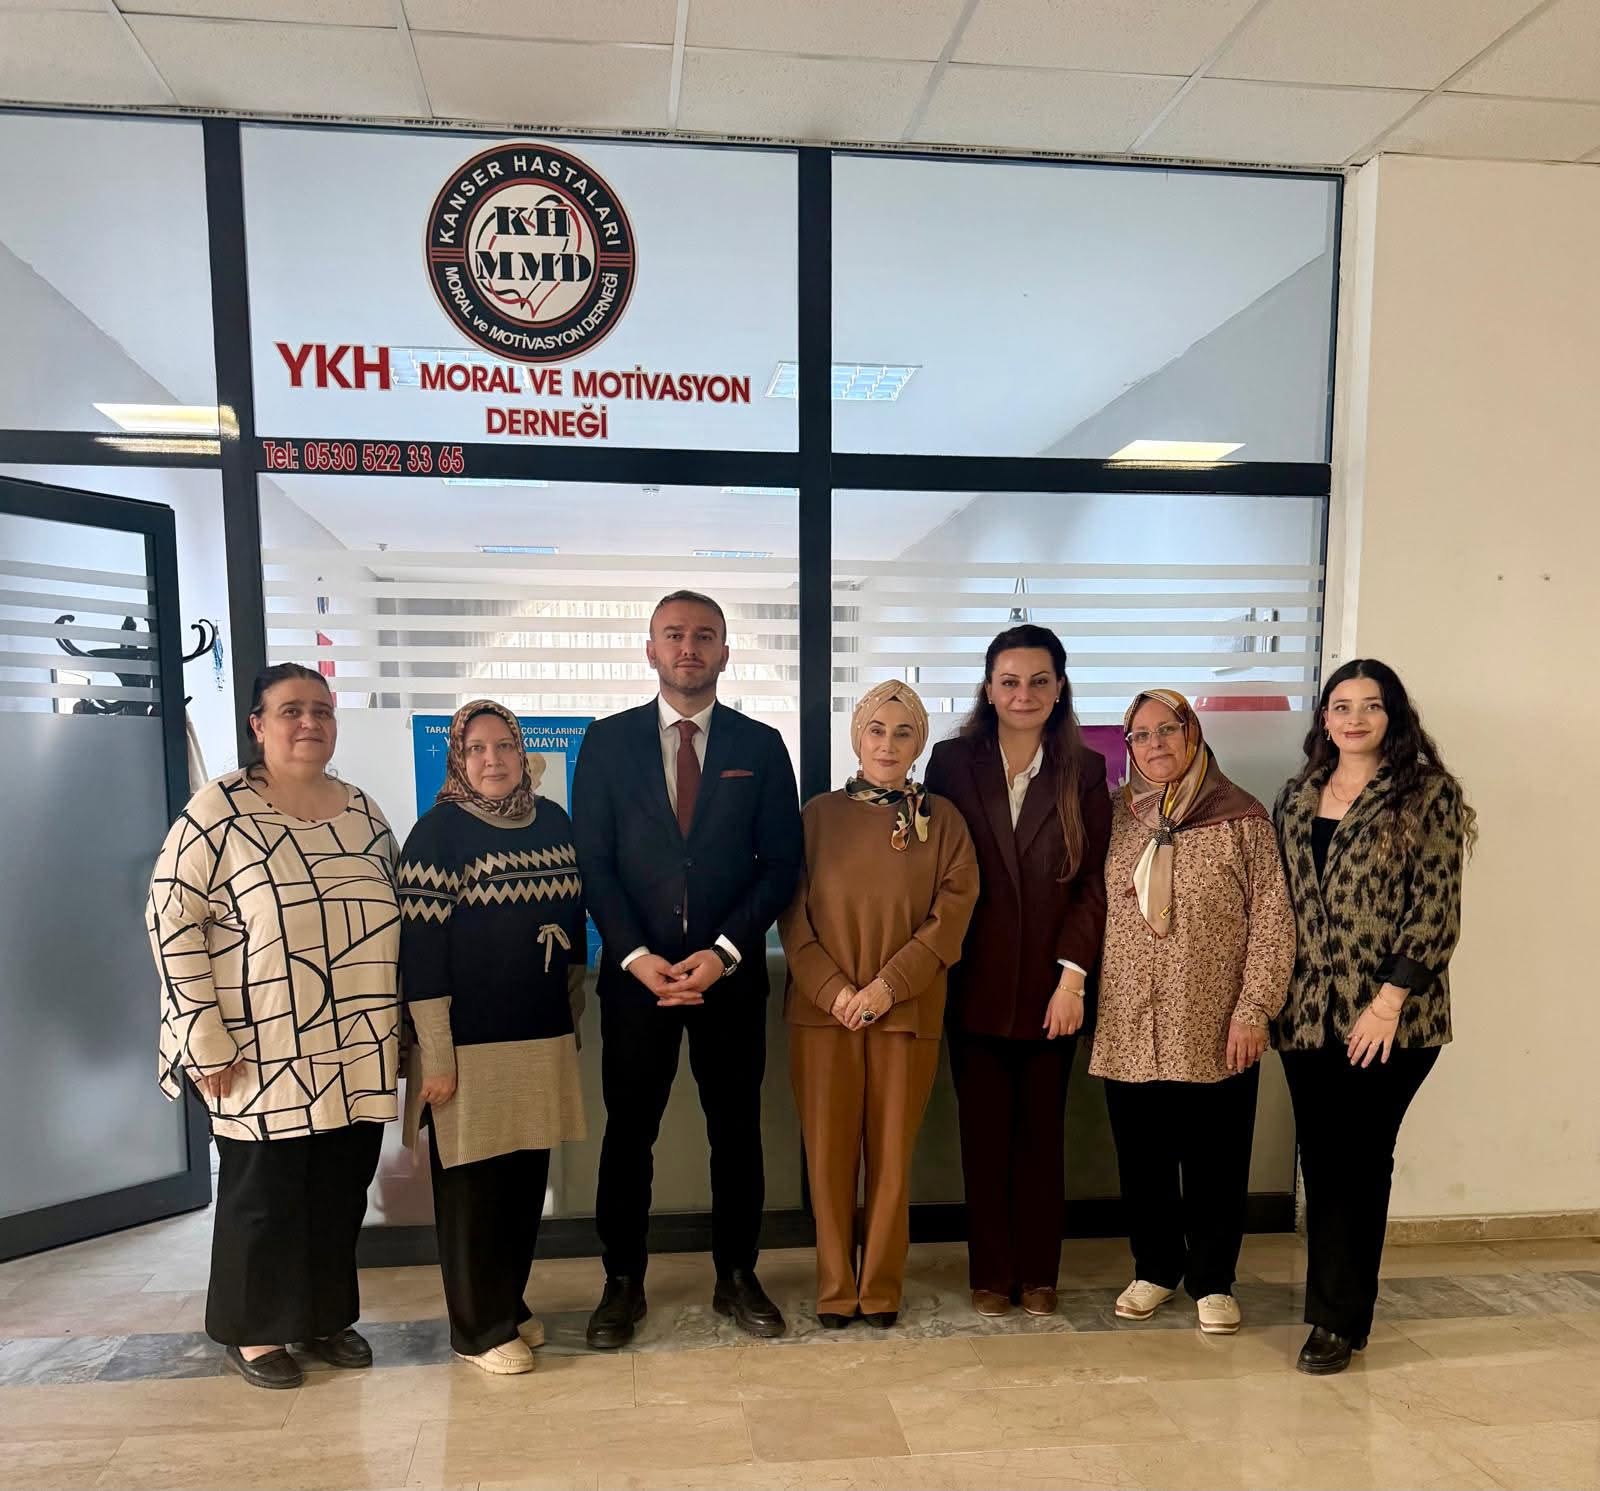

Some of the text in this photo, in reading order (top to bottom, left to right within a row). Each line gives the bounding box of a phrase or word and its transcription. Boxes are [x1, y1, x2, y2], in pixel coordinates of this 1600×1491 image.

[438, 155, 622, 246] KANSER HASTALARI
[493, 206, 571, 237] KH
[475, 250, 593, 283] MMD
[444, 266, 619, 351] MORAL ve MOTİVASYON DERNEĞİ
[275, 341, 752, 405] YKH MORAL VE MOTİVASYON
[485, 402, 608, 440] DERNEĞİ
[263, 440, 465, 474] Tel: 0530 522 33 65
[424, 726, 451, 734] TARA
